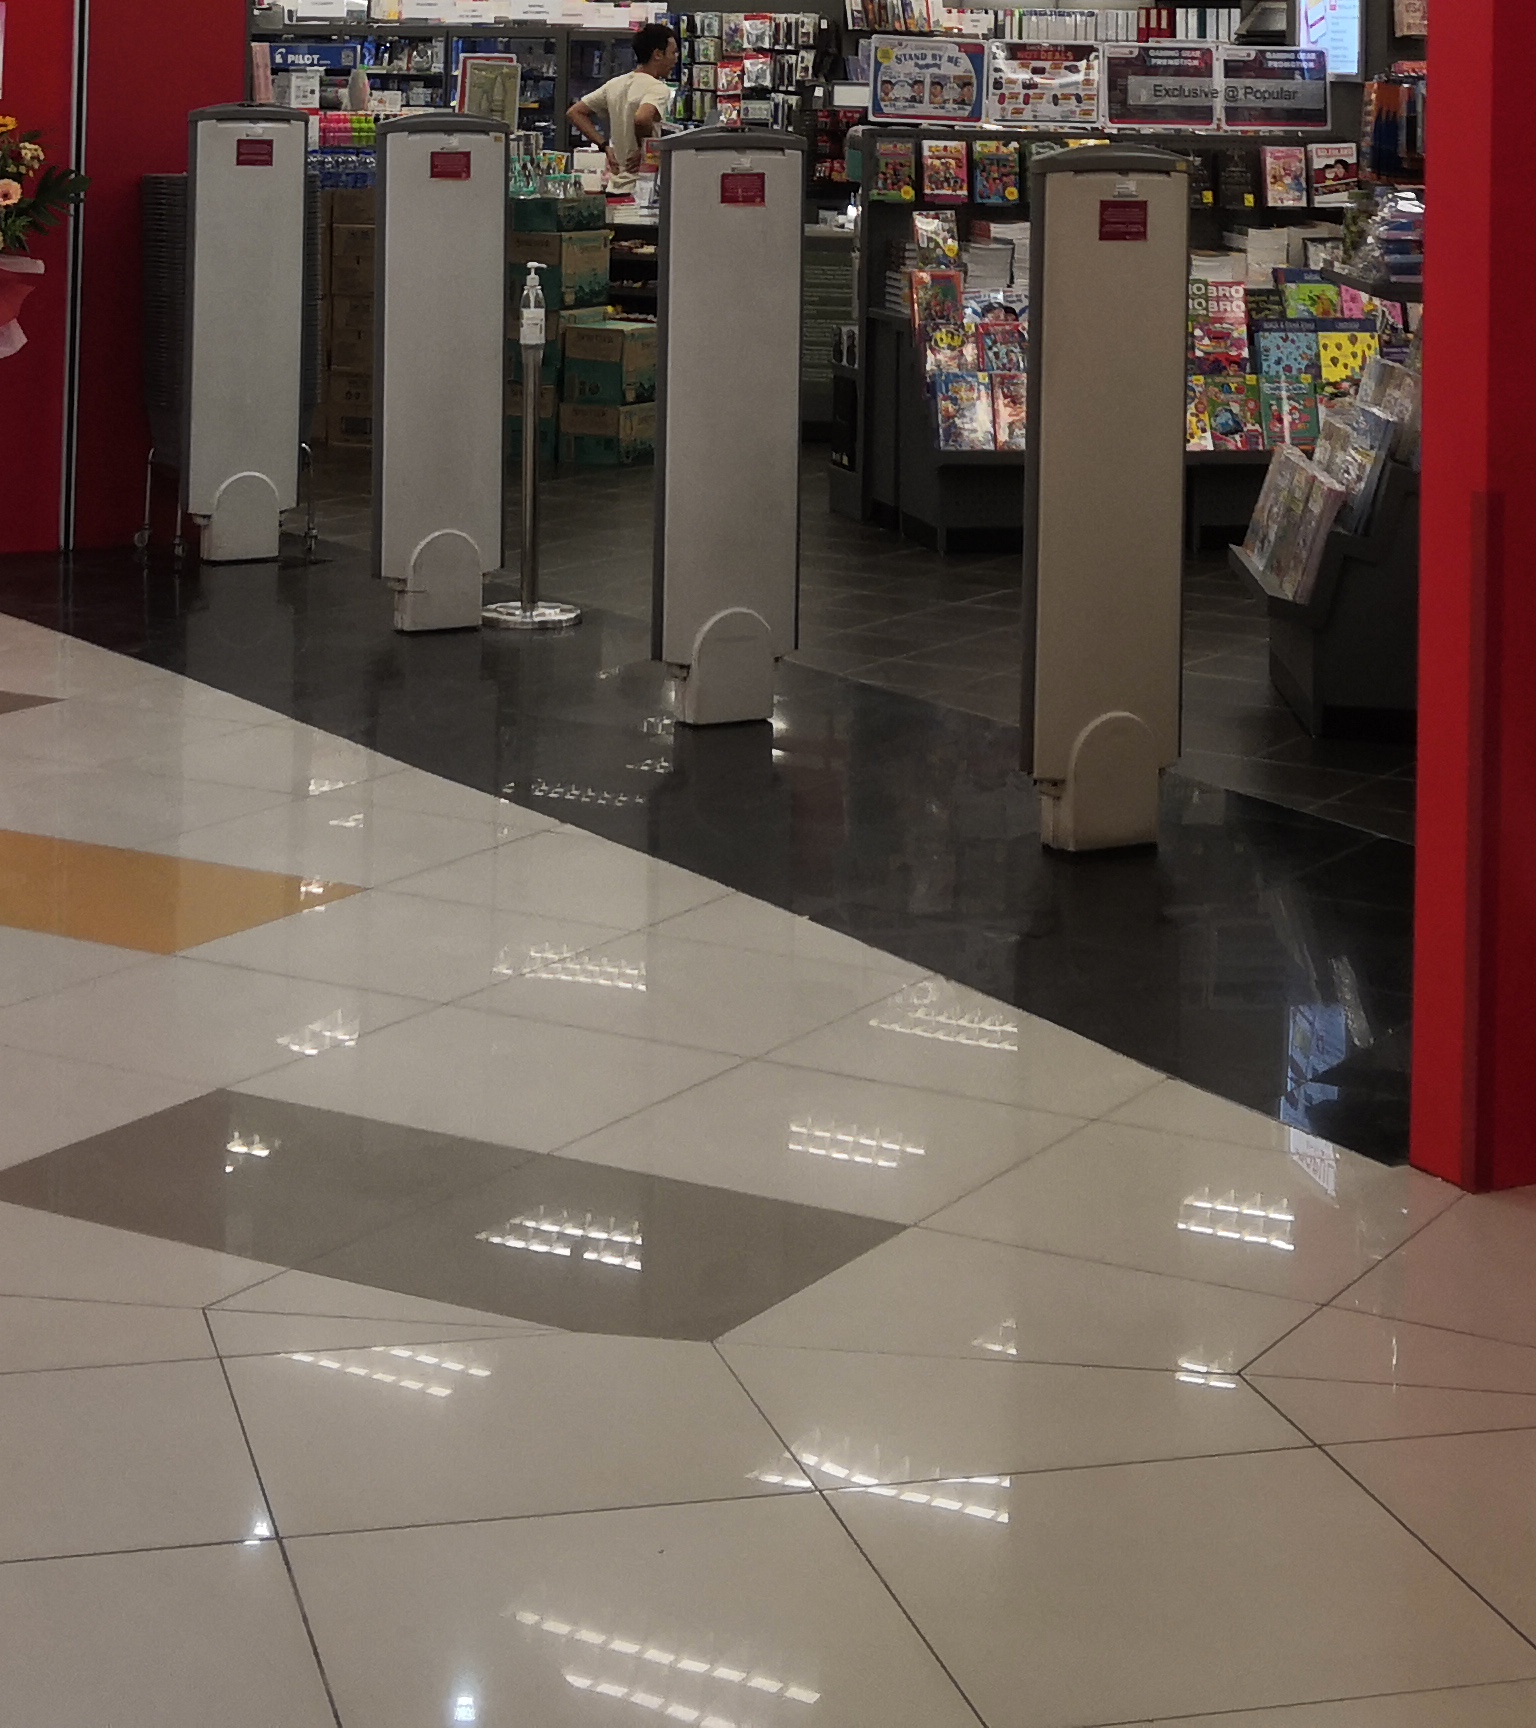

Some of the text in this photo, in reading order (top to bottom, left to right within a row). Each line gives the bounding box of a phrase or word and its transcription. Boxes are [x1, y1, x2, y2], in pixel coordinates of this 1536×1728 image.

[287, 54, 320, 65] PILOT
[895, 52, 927, 65] STAND
[931, 52, 943, 62] BY
[946, 54, 962, 68] ME
[1153, 83, 1299, 104] Exclusive @ Popular
